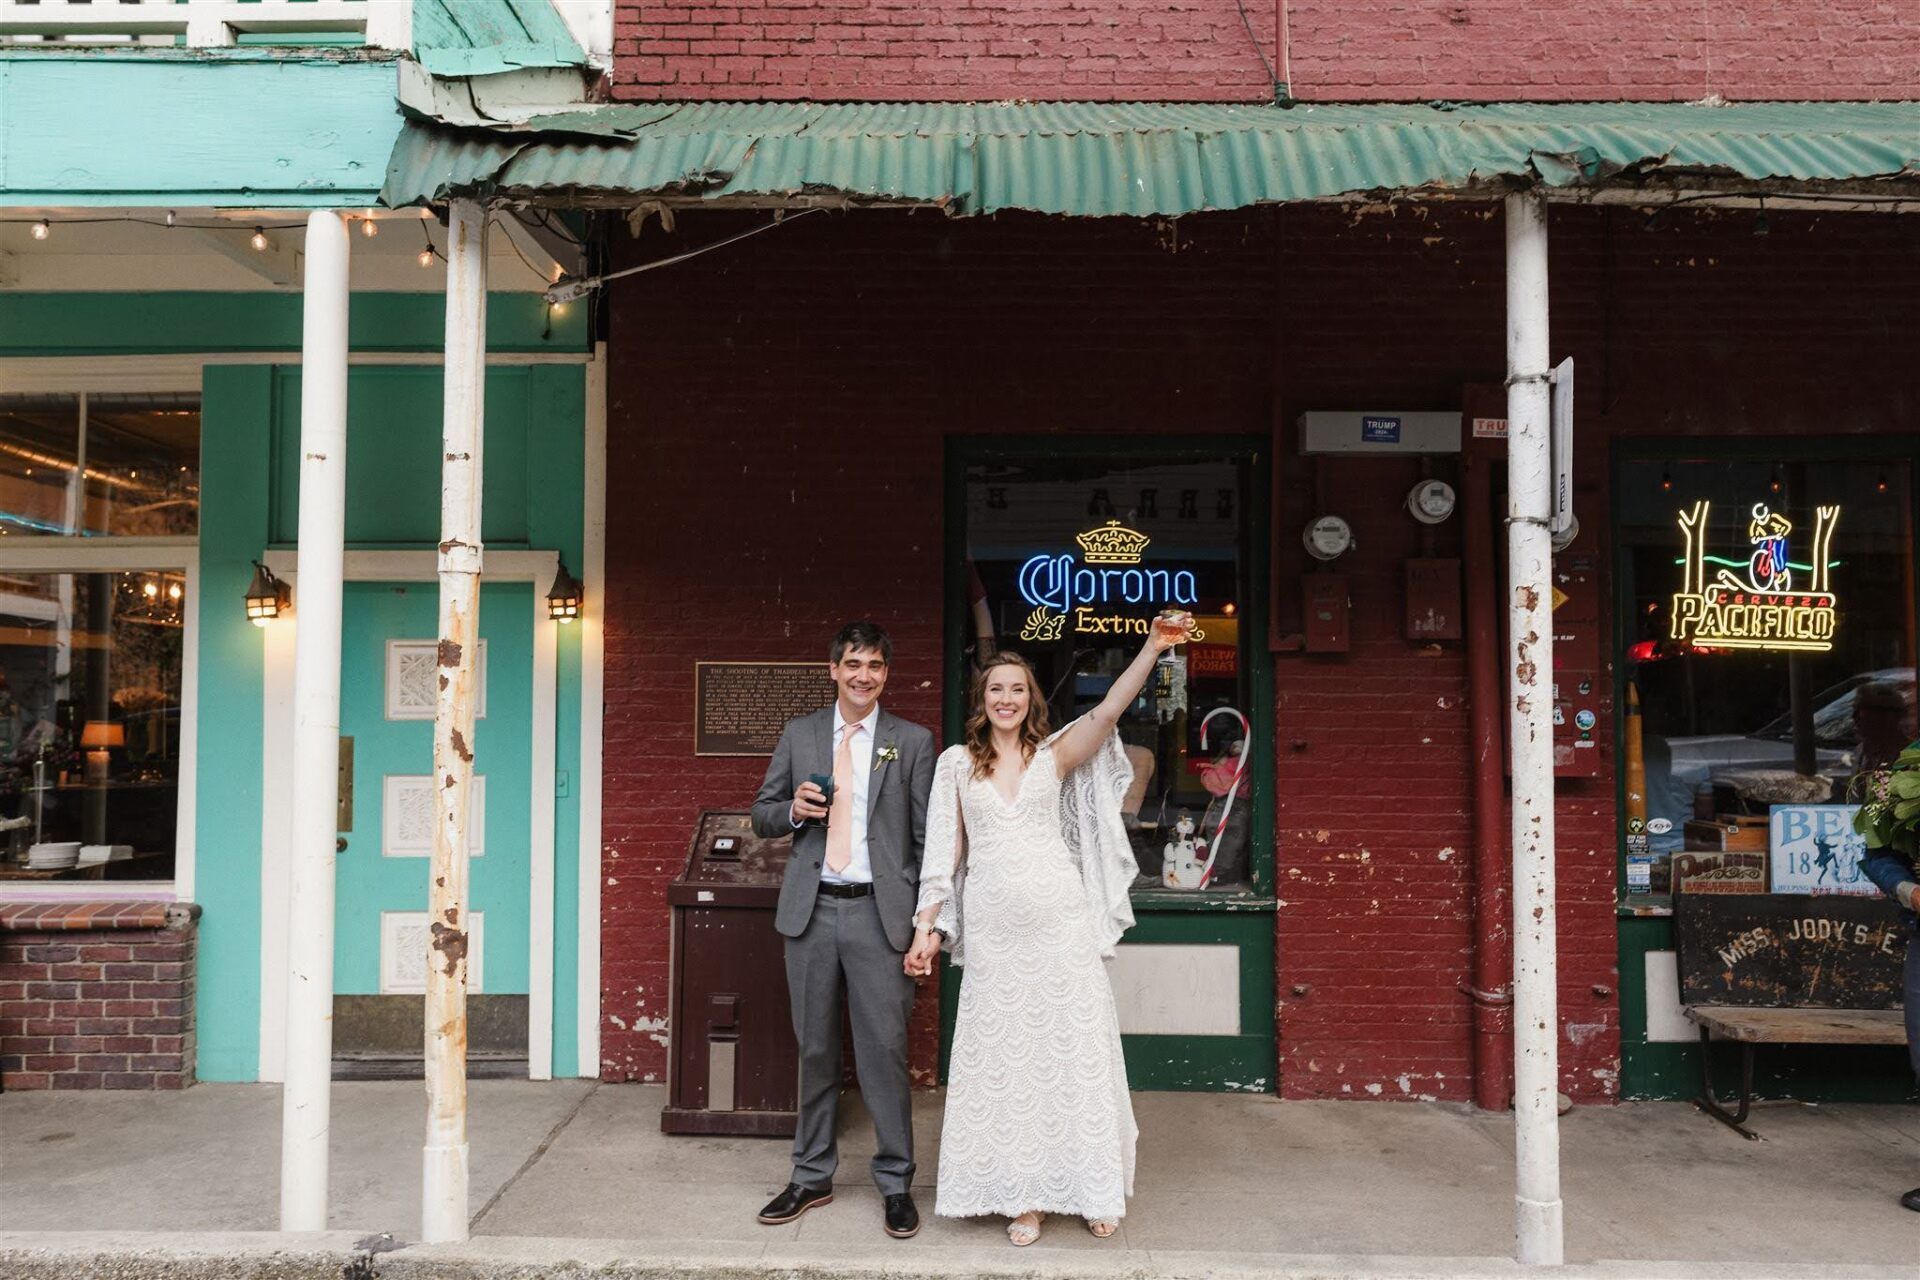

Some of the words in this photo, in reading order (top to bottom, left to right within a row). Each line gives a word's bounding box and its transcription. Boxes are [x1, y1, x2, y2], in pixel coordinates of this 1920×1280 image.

[1367, 421, 1396, 430] TRUMP
[1476, 420, 1506, 431] TRU
[1019, 554, 1198, 613] Corona
[1717, 593, 1831, 607] CERVEZA
[1075, 607, 1150, 635] Extra
[1671, 593, 1836, 640] PACIFICO
[1789, 852, 1811, 875] 18
[1717, 927, 1772, 968] MISS
[1788, 918, 1869, 945] JODY'S
